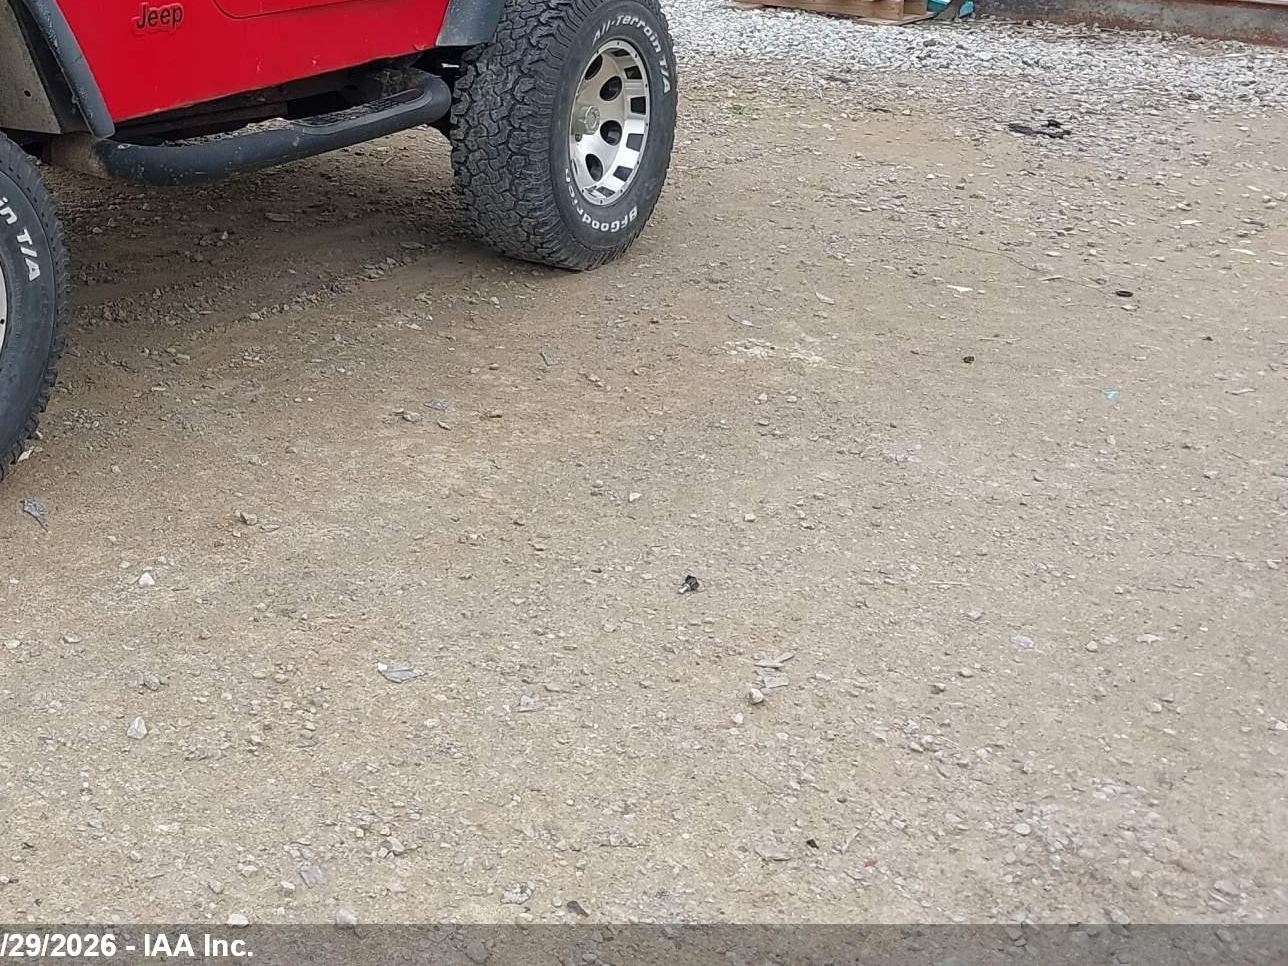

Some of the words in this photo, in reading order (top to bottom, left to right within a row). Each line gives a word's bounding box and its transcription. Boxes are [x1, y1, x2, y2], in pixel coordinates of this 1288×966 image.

[135, 4, 183, 29] Jeep
[592, 14, 662, 54] All-Terrain
[658, 55, 671, 94] T/A
[564, 167, 638, 233] BFGoodrich
[16, 228, 42, 282] T/A
